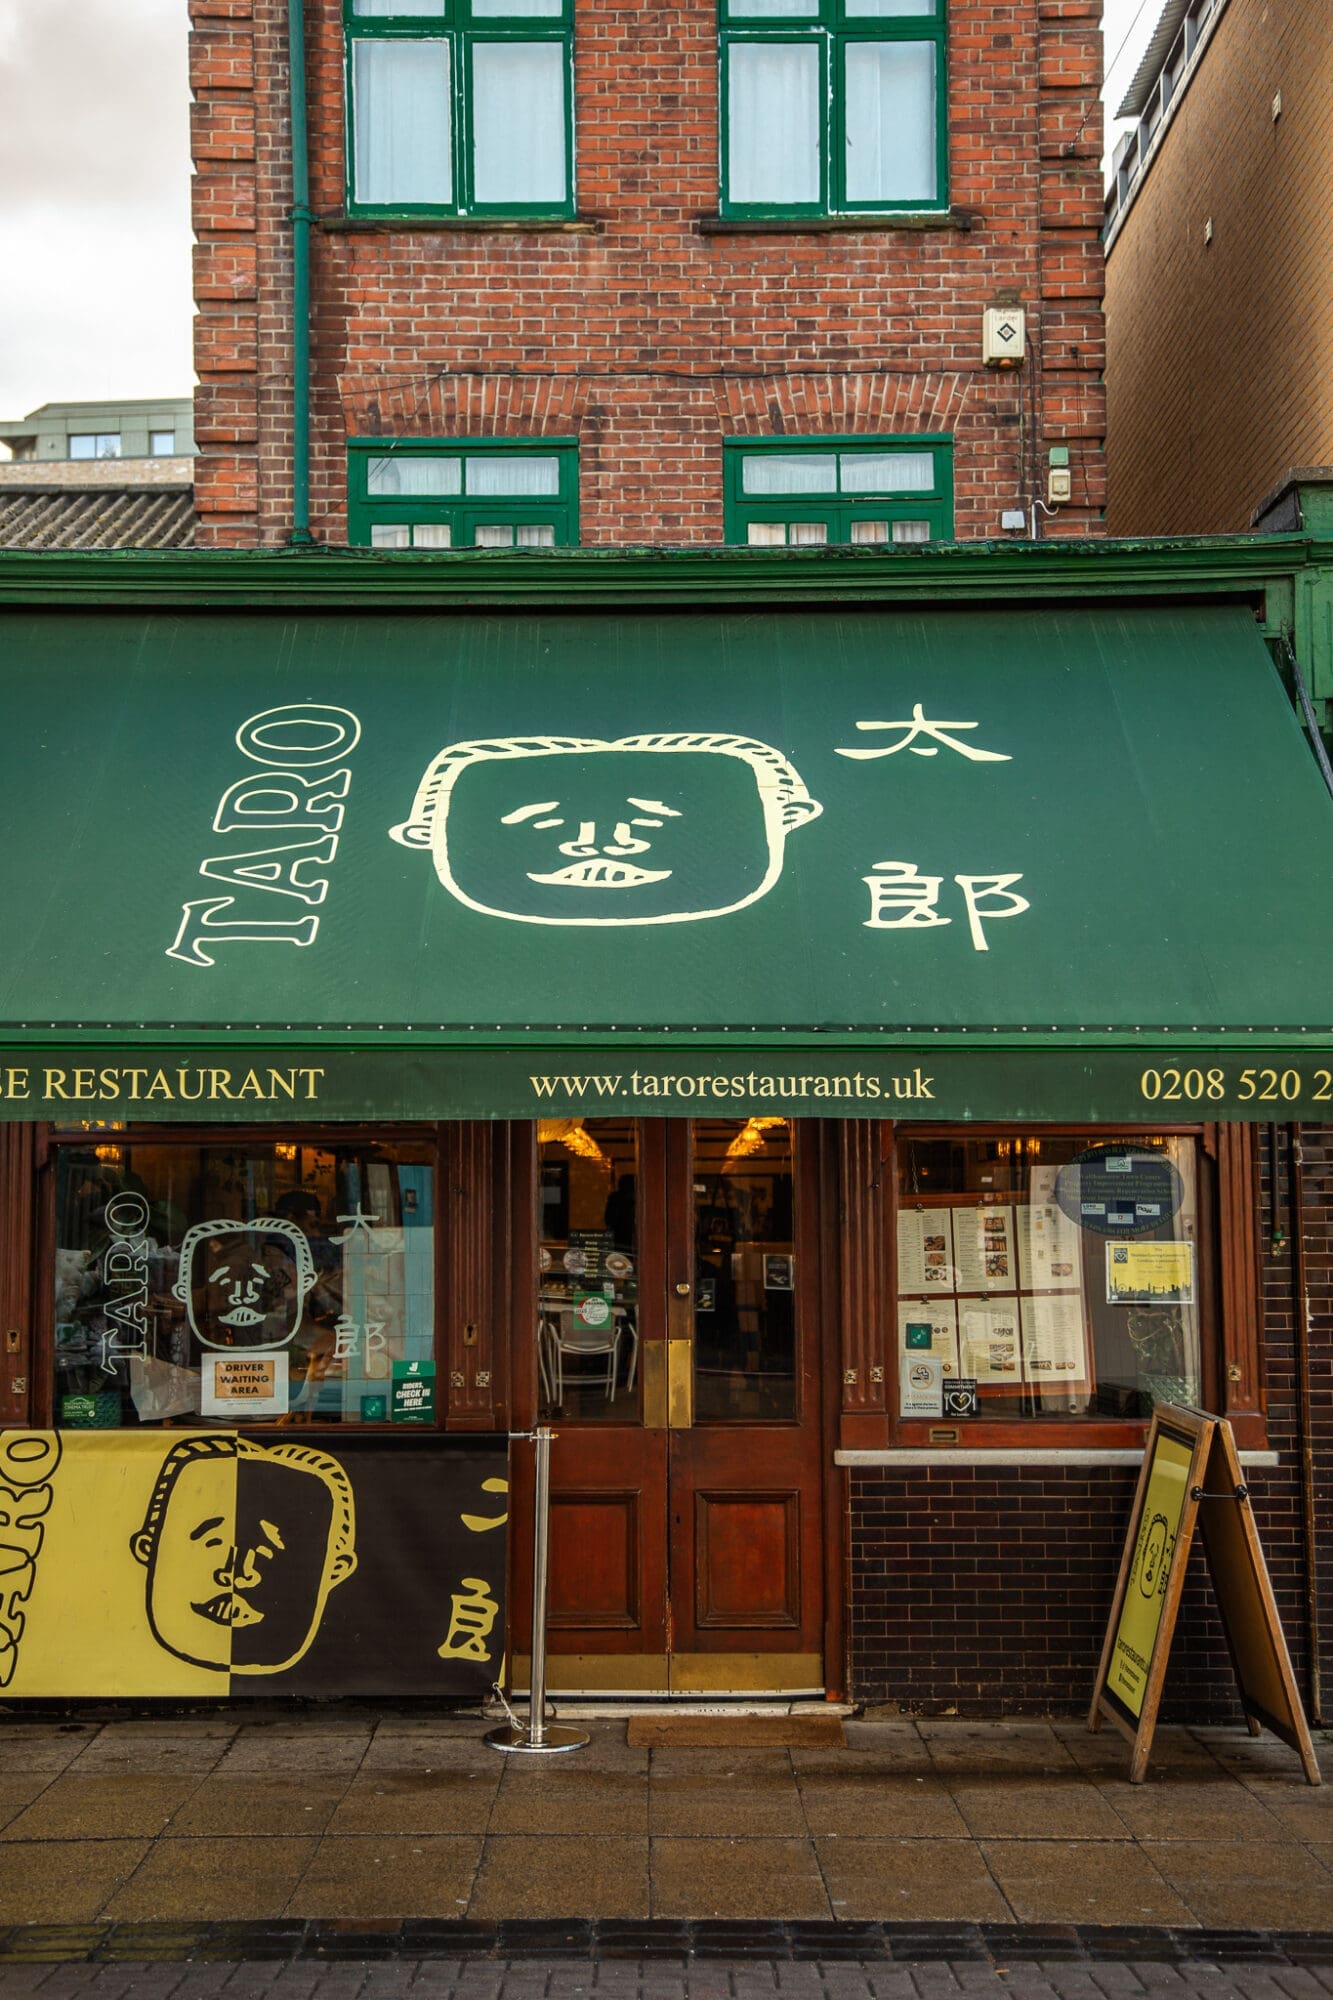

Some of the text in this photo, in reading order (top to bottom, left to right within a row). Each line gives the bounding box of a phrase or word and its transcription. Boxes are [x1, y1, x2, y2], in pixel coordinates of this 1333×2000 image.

[166, 704, 361, 966] TARO
[0, 1068, 325, 1099] E RESTAURANT
[529, 1068, 936, 1099] www.tarorestaurants.uk
[1141, 1068, 1225, 1100] 0208
[1238, 1069, 1301, 1100] 520
[100, 1191, 150, 1375] TARO
[225, 1363, 265, 1372] DRIVER
[220, 1375, 269, 1383] WAITING
[230, 1386, 259, 1394] AREA
[396, 1388, 431, 1399] CHECK IN
[403, 1398, 423, 1407] HERE
